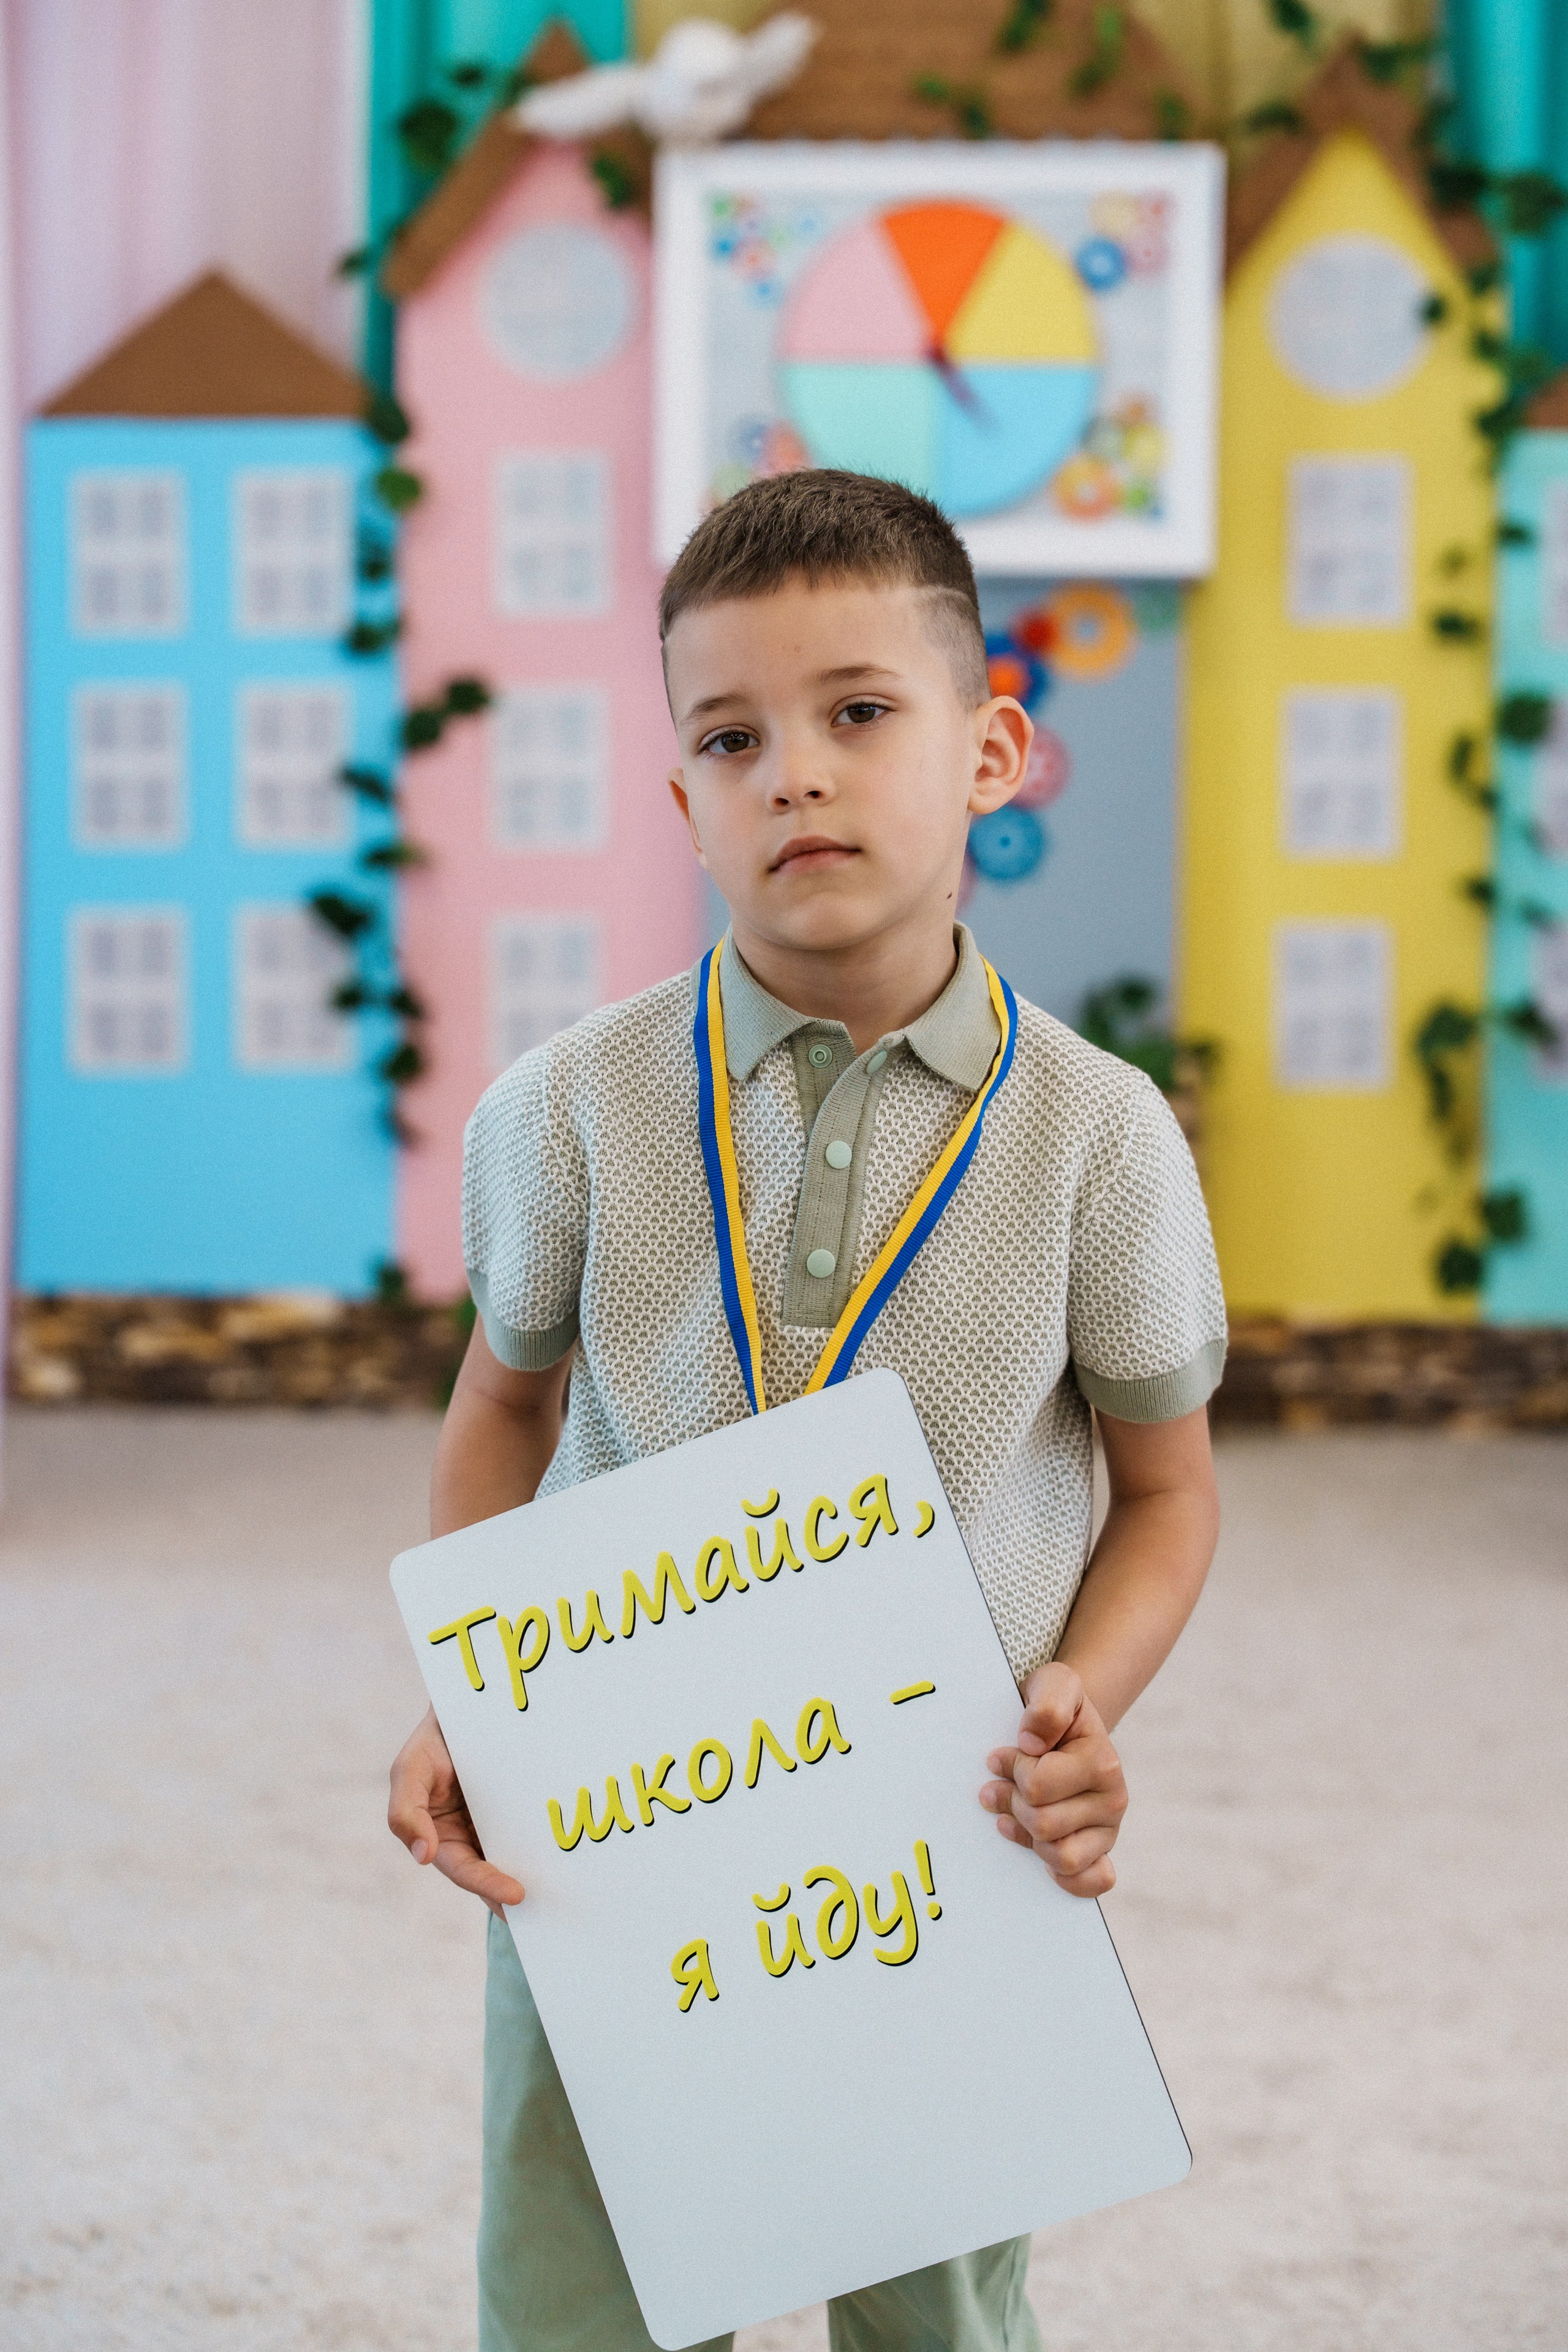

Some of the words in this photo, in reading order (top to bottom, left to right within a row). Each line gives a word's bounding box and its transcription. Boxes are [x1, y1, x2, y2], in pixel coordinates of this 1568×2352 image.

[428, 1474, 936, 1711] Тримайся,
[547, 1697, 851, 1851] школа
[670, 1938, 720, 2013] я
[752, 1839, 943, 1978] йду!
